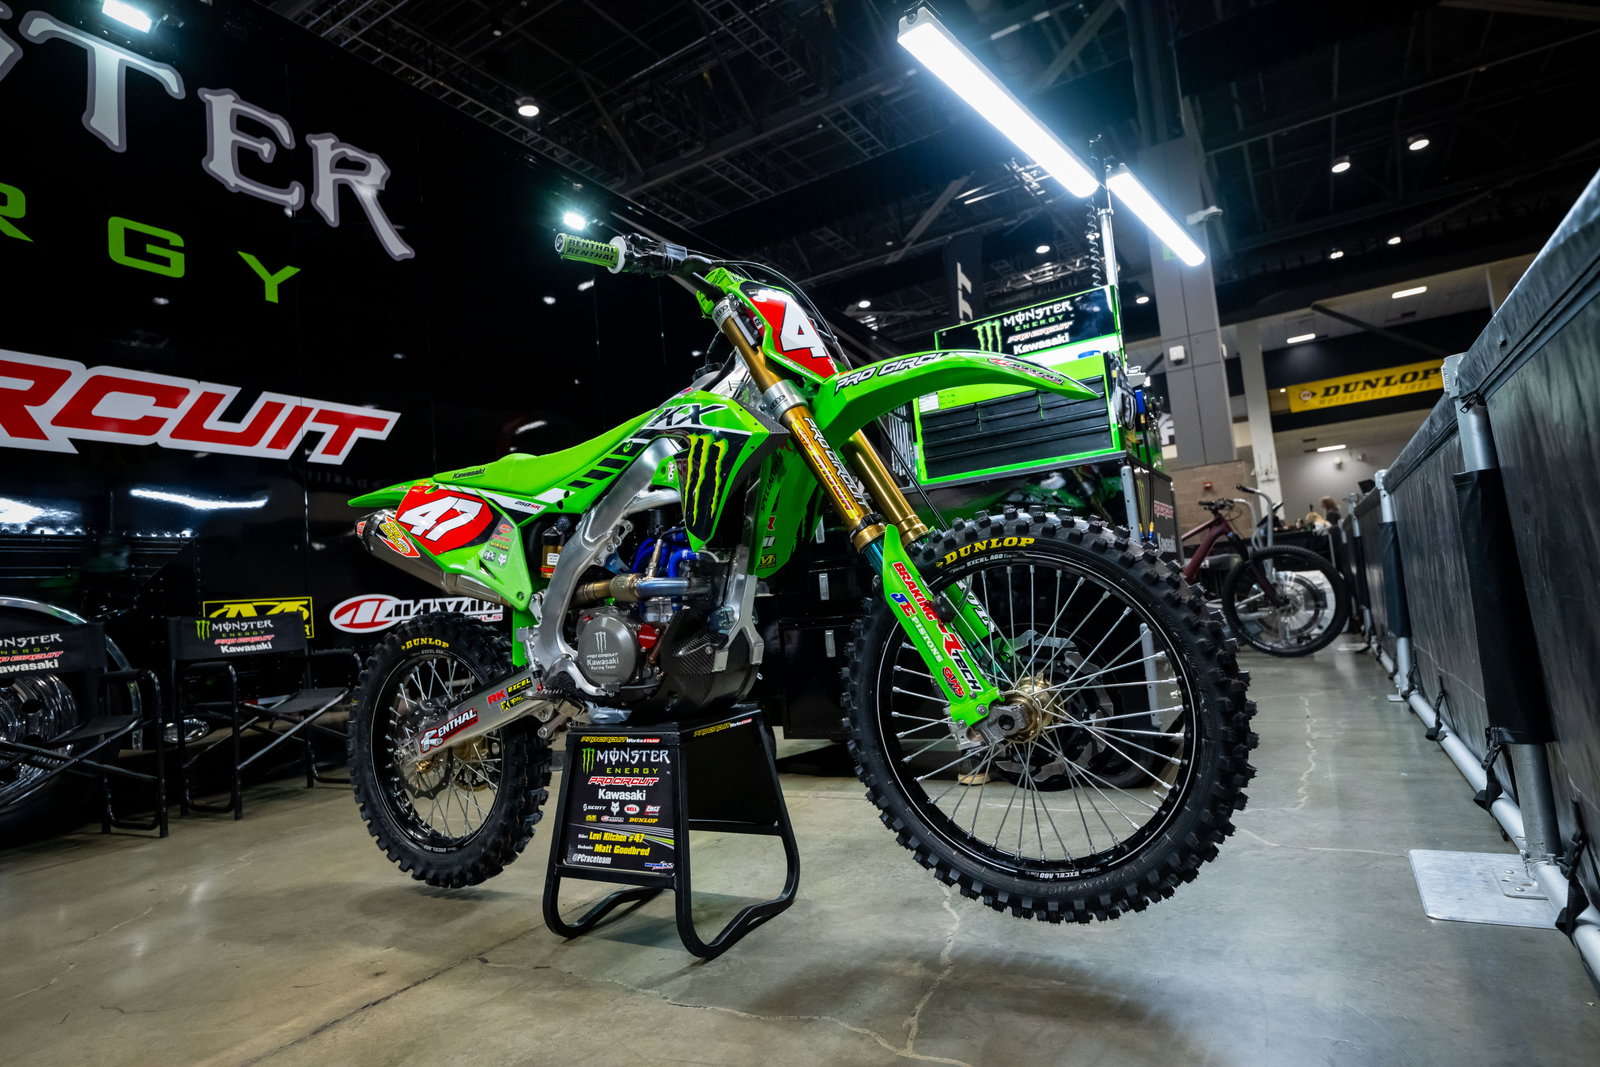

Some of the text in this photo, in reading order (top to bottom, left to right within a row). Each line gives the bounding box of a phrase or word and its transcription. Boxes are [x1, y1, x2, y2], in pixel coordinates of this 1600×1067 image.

[568, 239, 617, 253] RENTHAL
[568, 246, 616, 261] RENTHAL
[1003, 300, 1073, 327] MONSTER
[780, 300, 828, 358] 4
[1015, 314, 1064, 332] ENERGY
[1013, 332, 1070, 355] Kawasaki
[834, 366, 877, 393] PRO
[1321, 367, 1441, 398] DUNLOP
[1319, 388, 1391, 405] MOTORCYCLE
[650, 404, 728, 427] KX
[452, 467, 486, 479] Kawasaki
[803, 417, 874, 514] PRO CIRCUIT
[396, 496, 484, 542] 47
[943, 537, 1036, 566] DUNLOP
[990, 553, 1004, 561] A60
[892, 561, 938, 622] BRAKING
[211, 619, 274, 633] MONSTER
[222, 629, 265, 638] ENERGY
[0, 633, 64, 648] NSTER
[220, 641, 273, 654] Kawasaki
[405, 637, 450, 650] DUNLOP
[910, 615, 944, 663] PISTONS
[586, 657, 620, 666] Kawasaki
[942, 666, 965, 698] GUTS
[487, 690, 507, 705] RK
[507, 678, 531, 693] EXCEL
[420, 709, 478, 752] RENTHAL
[596, 747, 671, 766] MONSTER
[606, 767, 660, 775] ENERGY
[587, 776, 660, 788] PRO CIRCUIT
[598, 788, 647, 801] Kawasaki
[589, 831, 602, 841] Levi
[603, 832, 627, 842] Kitchen
[628, 833, 646, 843] #47
[593, 843, 613, 854] Matt
[613, 845, 651, 856] Goodbred
[571, 853, 612, 865] @PCraceteam
